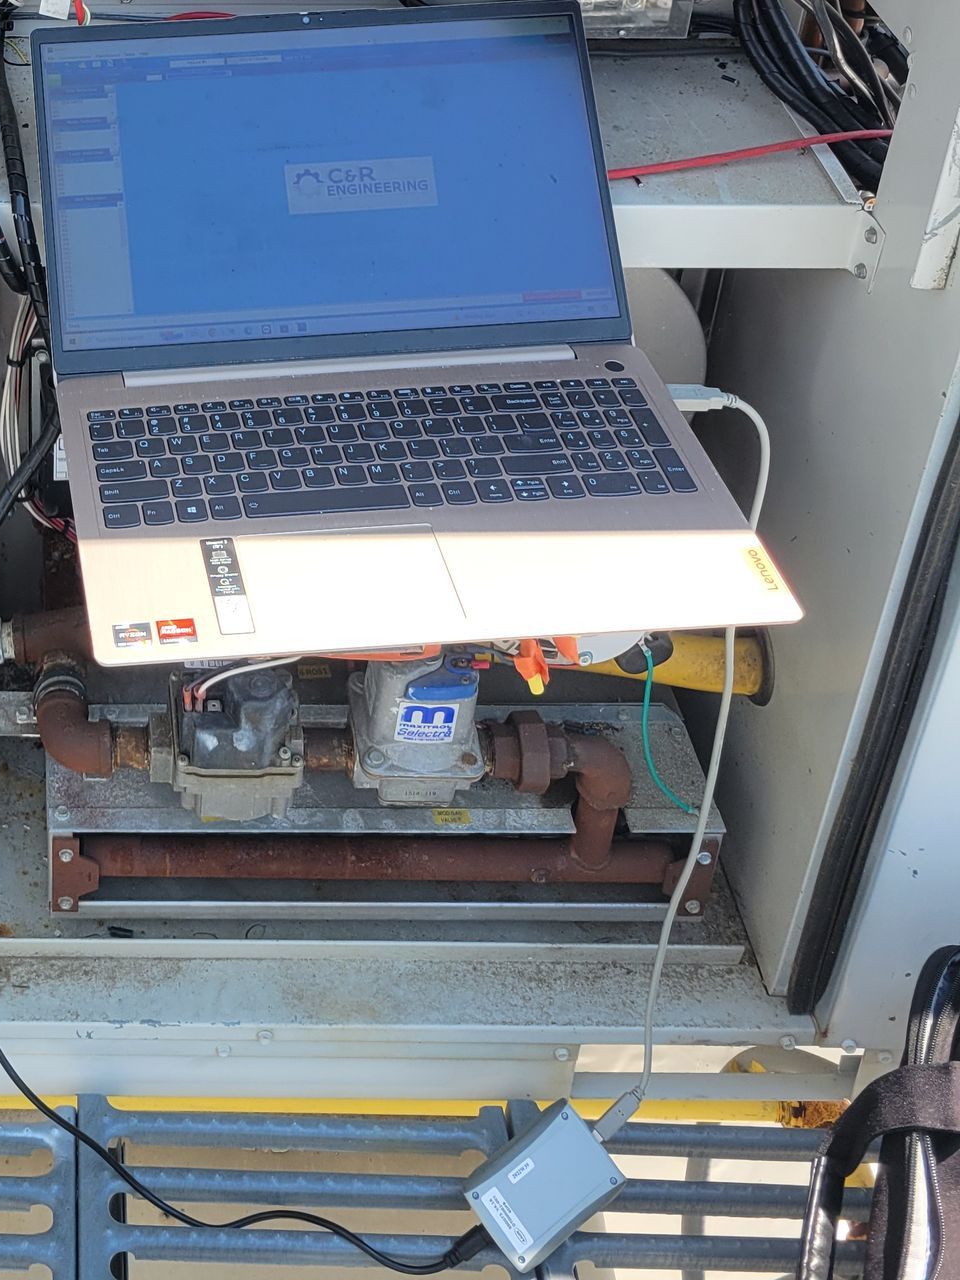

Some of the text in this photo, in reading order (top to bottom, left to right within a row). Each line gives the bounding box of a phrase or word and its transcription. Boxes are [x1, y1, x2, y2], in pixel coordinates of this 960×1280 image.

[328, 166, 376, 184] C&R
[327, 179, 429, 197] ENGINEERING
[748, 549, 779, 591] Lenovo
